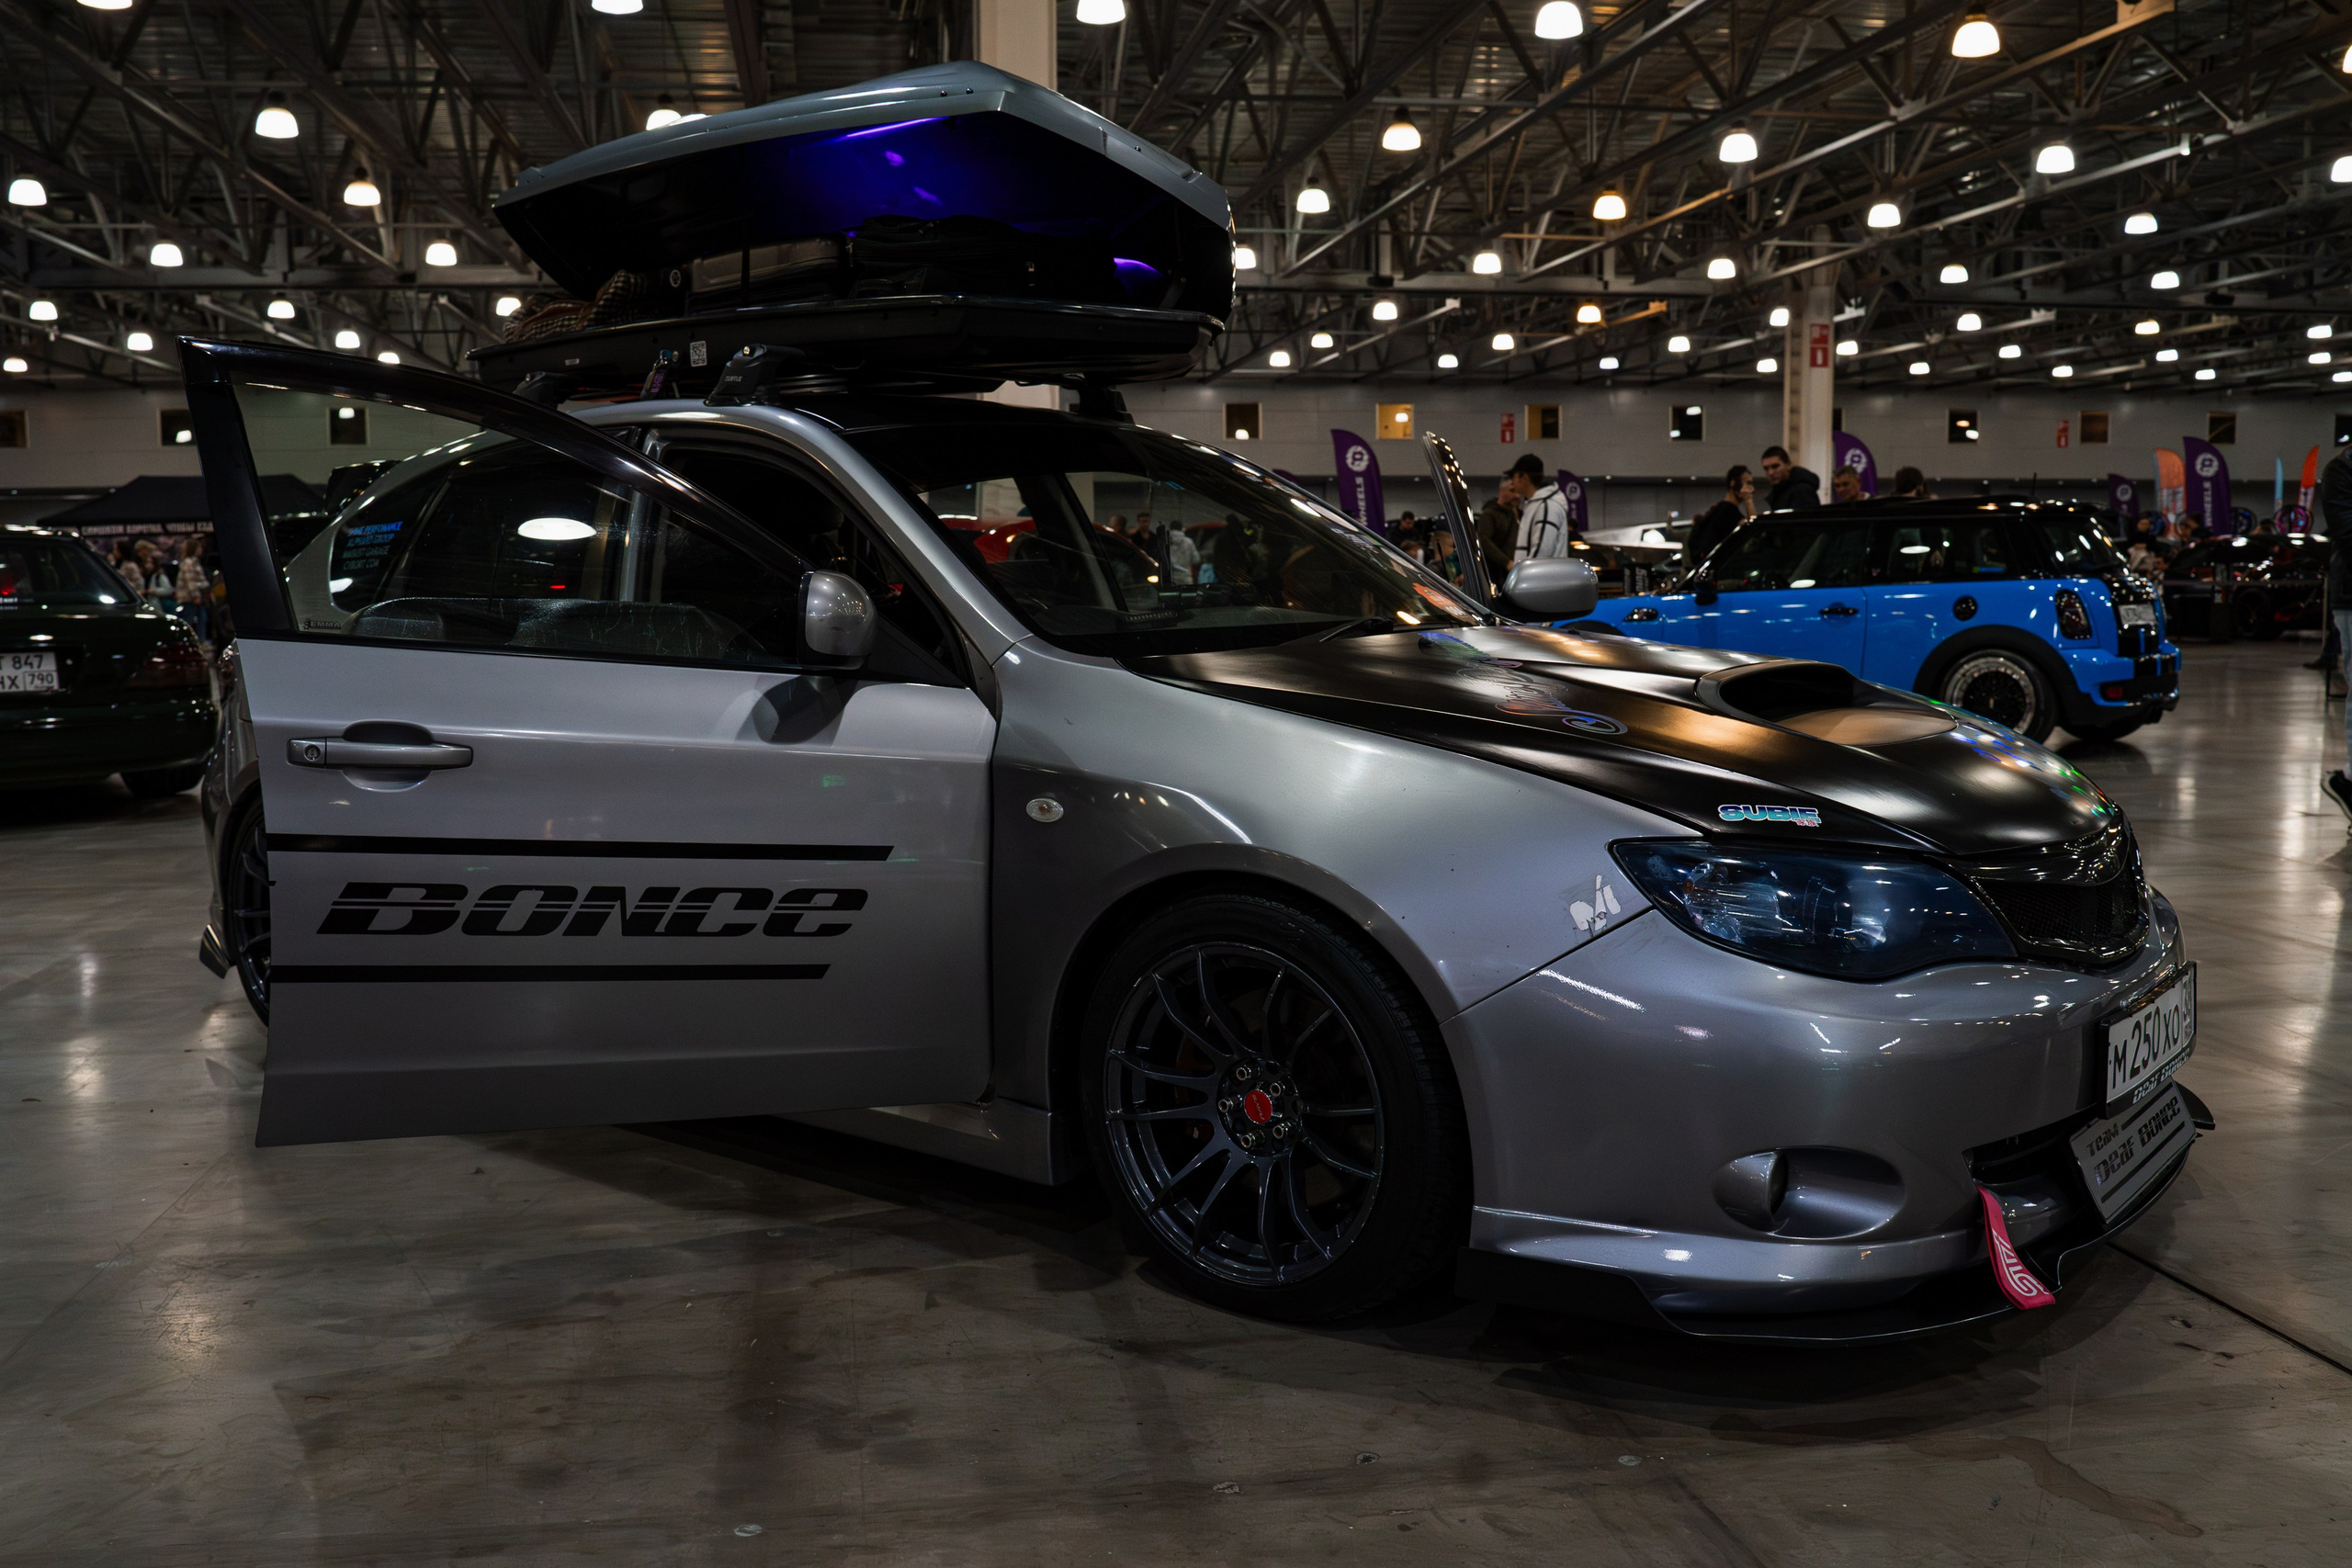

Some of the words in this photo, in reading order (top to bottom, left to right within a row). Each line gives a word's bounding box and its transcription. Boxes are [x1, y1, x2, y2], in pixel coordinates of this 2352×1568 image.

[12, 655, 43, 670] 847
[28, 672, 54, 685] 790
[1717, 804, 1822, 824] SUBIE
